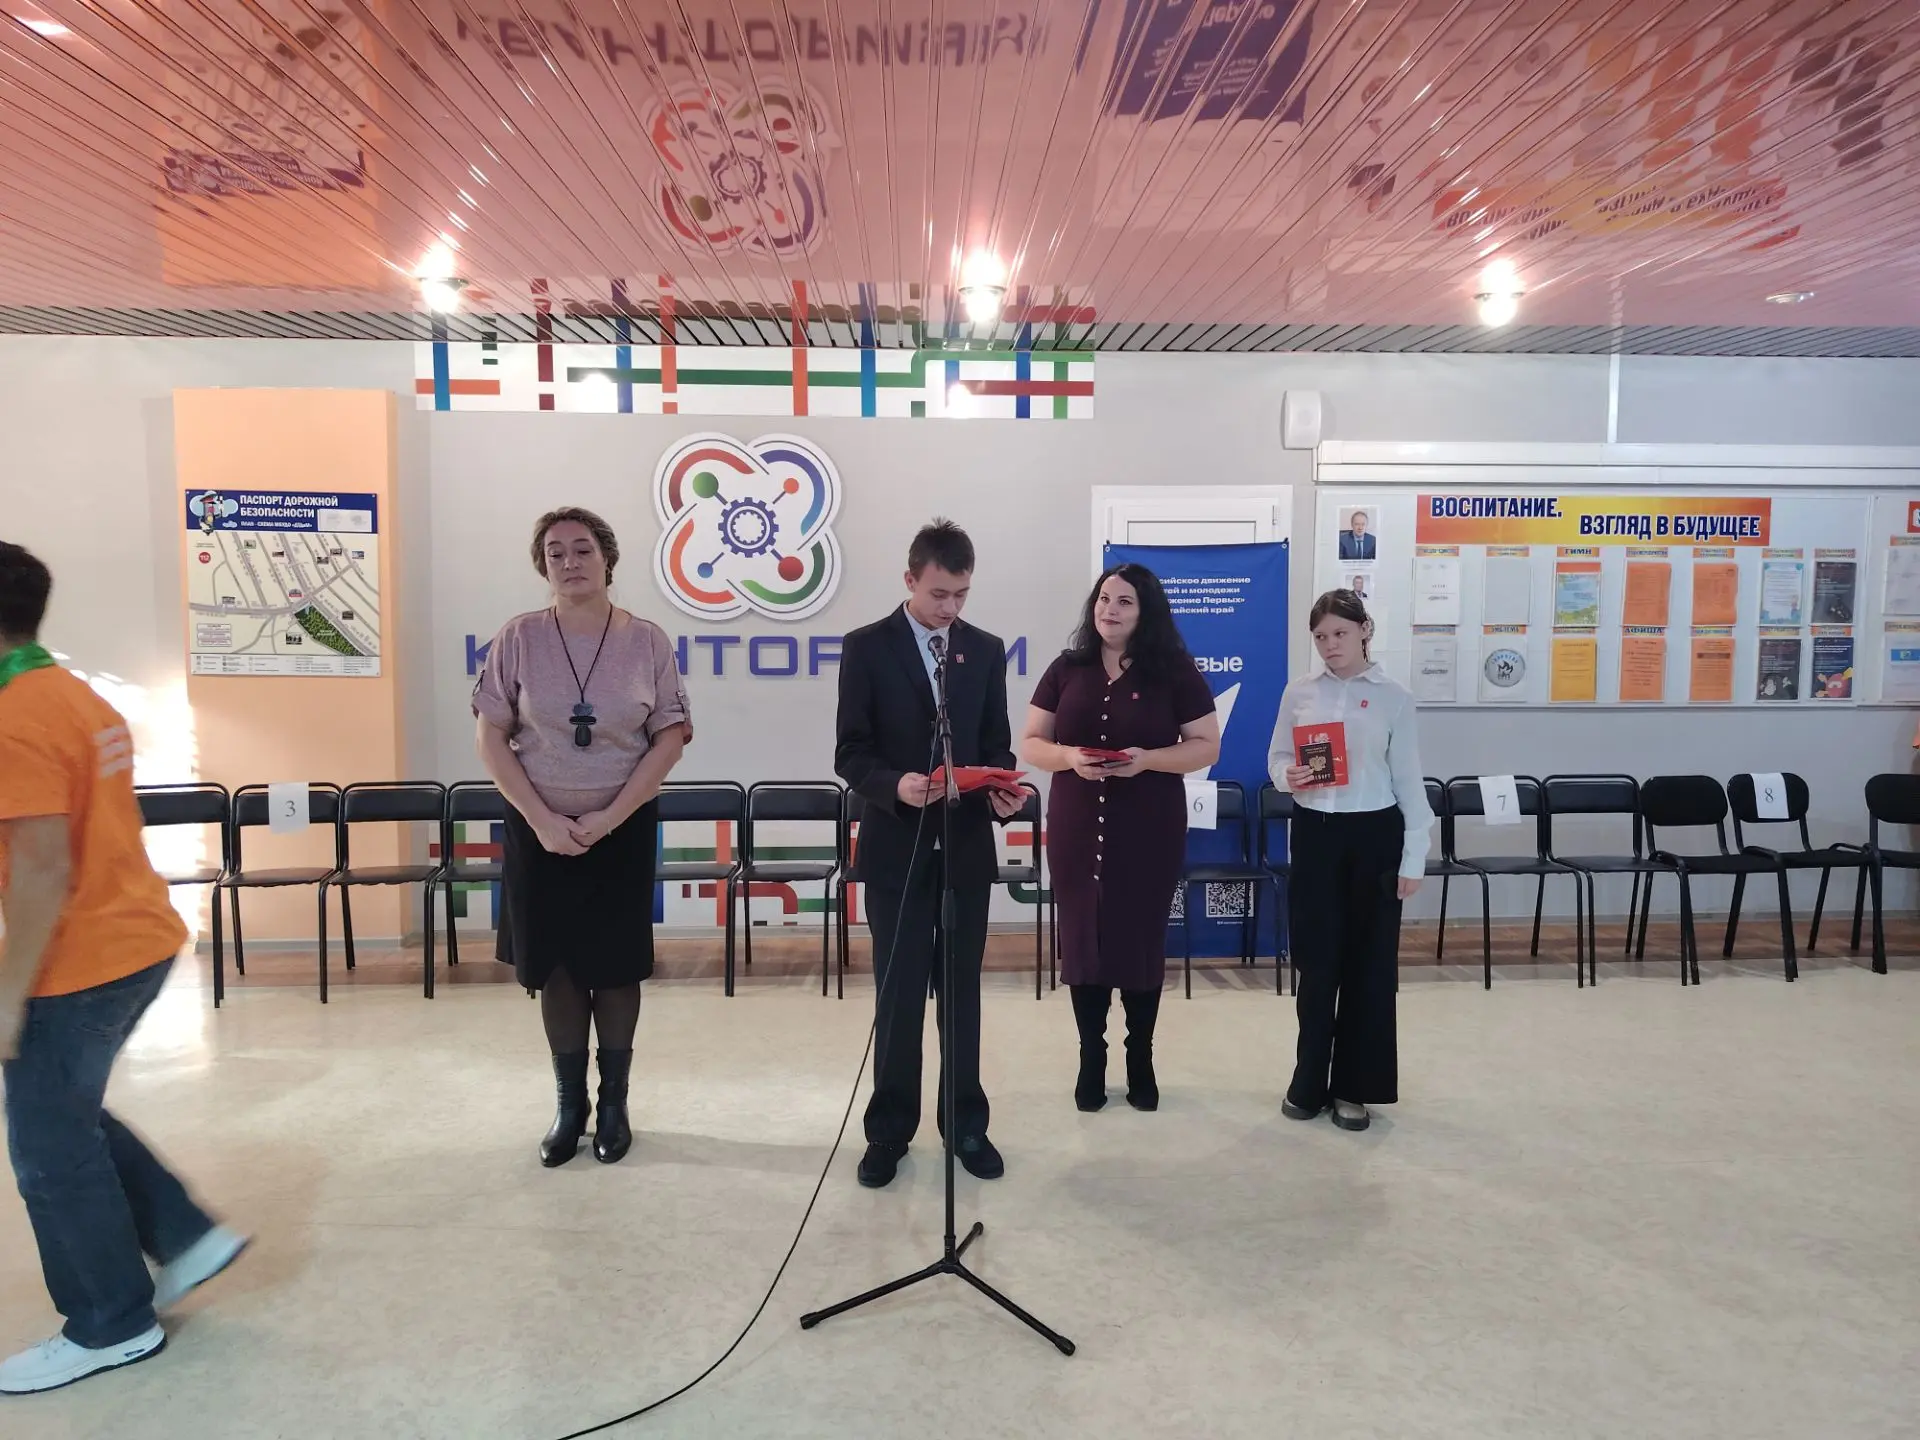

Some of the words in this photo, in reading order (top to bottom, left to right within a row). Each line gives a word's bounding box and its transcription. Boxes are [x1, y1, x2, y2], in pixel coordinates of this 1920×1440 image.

[240, 495, 283, 505] ПАСПОРТ
[284, 495, 339, 507] ДОРОЖНОЙ
[1431, 497, 1562, 518] ВОСПИТАНИЕ.
[240, 507, 315, 518] БЕЗОПАСНОСТИ
[1580, 515, 1651, 540] ВЗГЛЯД
[1656, 516, 1668, 535] В
[1674, 516, 1760, 540] БУДУЩЕЕ
[1159, 577, 1199, 585] сийское
[1201, 577, 1251, 585] движение
[1189, 587, 1240, 595] молодежи
[1210, 606, 1234, 614] край
[1194, 656, 1244, 673] вые
[1496, 794, 1506, 813] 7
[1764, 787, 1774, 804] 8
[285, 800, 296, 817] 3
[1193, 796, 1204, 813] 6
